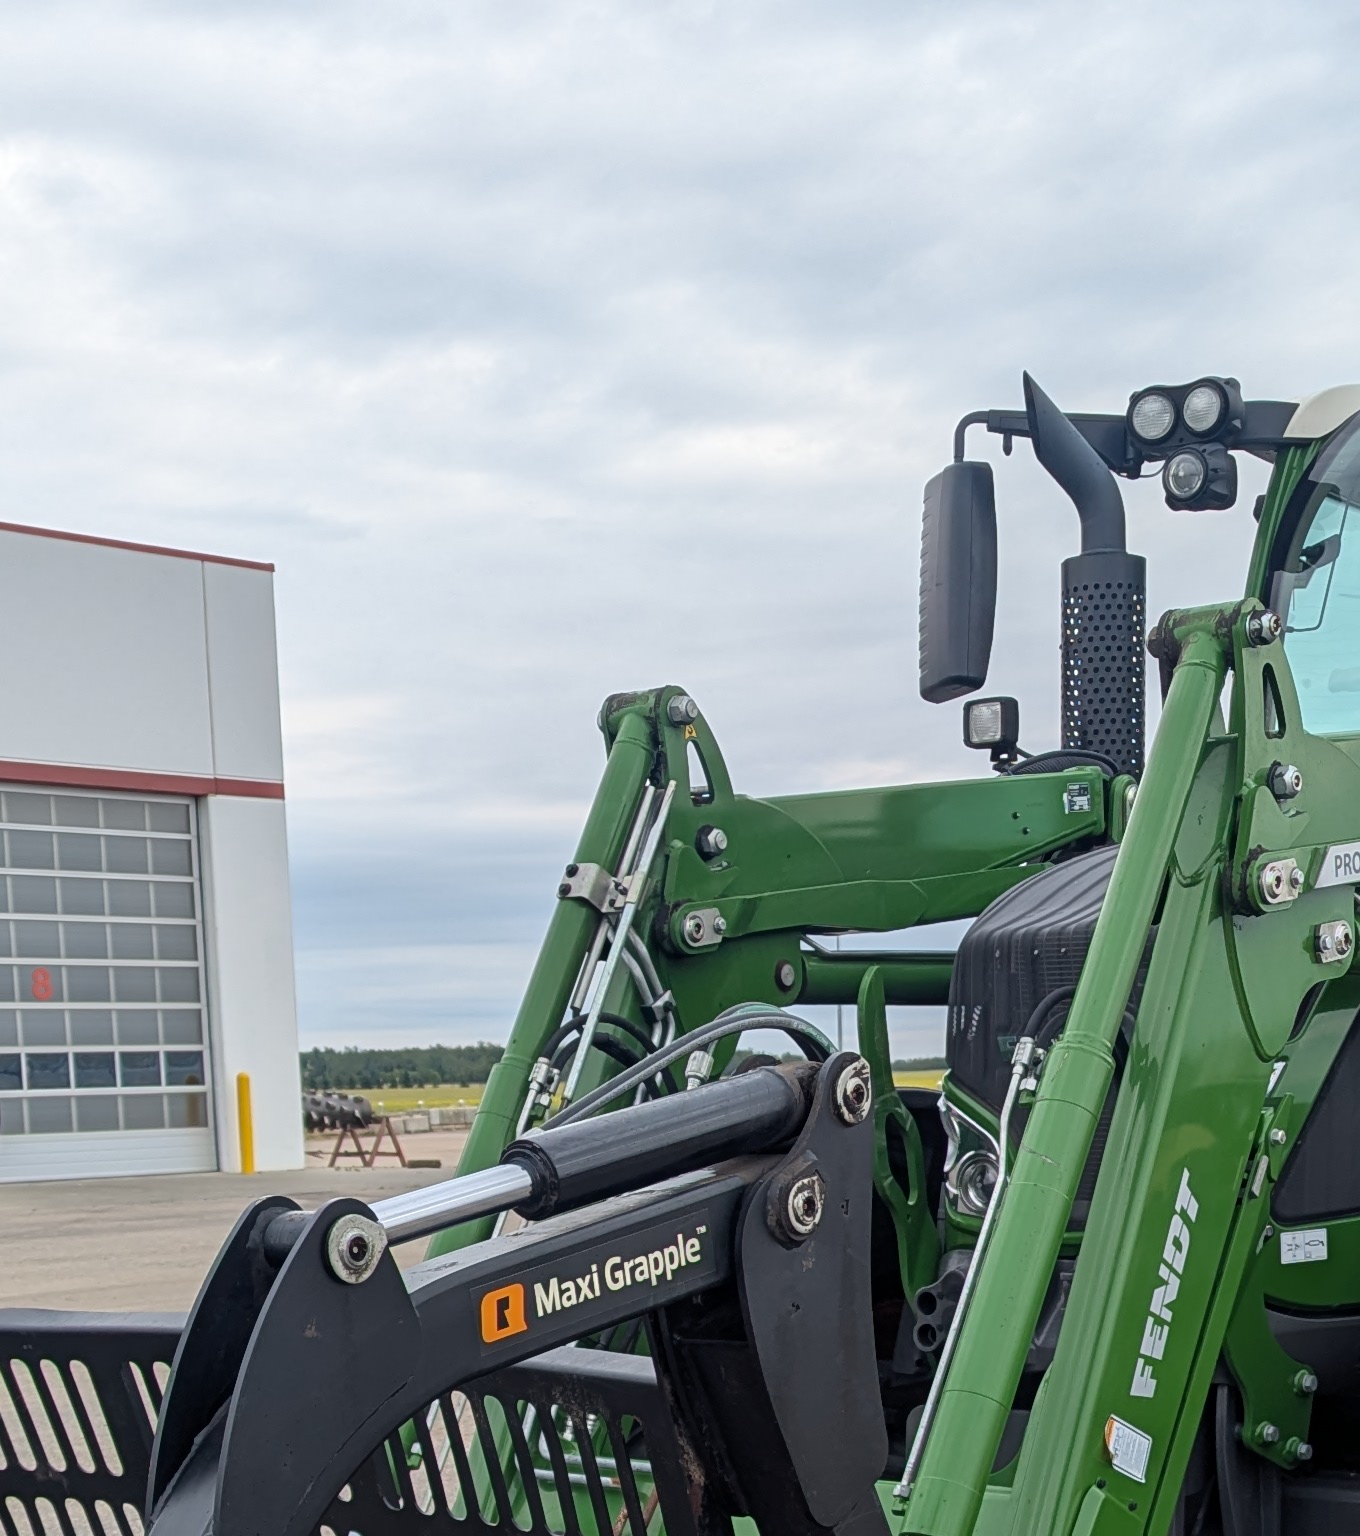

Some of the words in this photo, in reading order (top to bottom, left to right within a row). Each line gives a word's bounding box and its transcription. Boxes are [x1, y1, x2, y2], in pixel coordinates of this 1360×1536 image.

[31, 967, 52, 1001] 8
[533, 1264, 601, 1317] Maxi
[1130, 1167, 1199, 1398] FENDT
